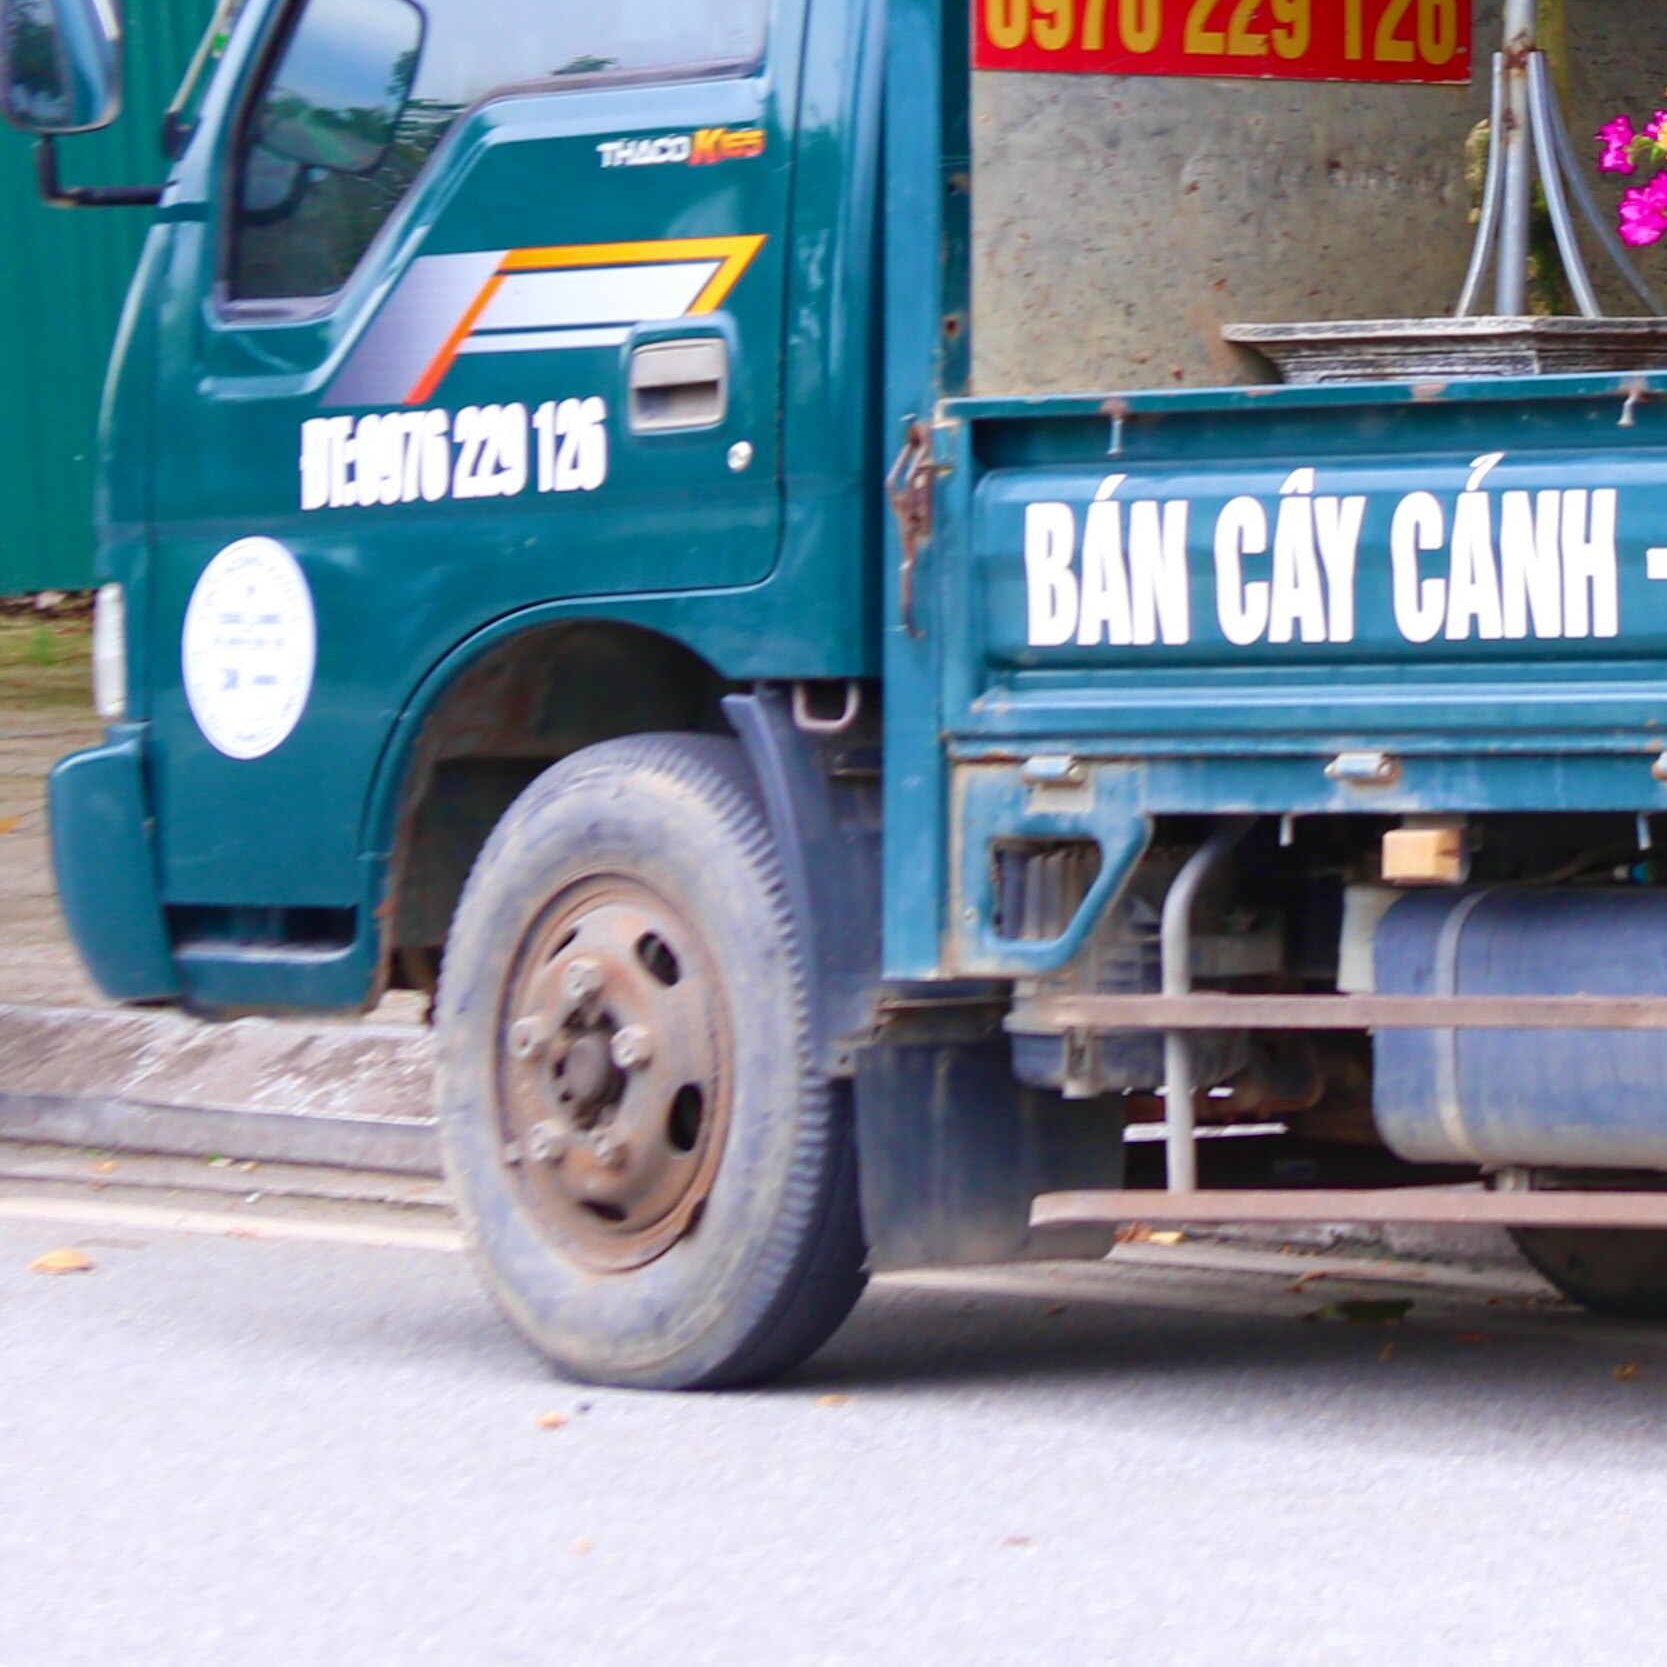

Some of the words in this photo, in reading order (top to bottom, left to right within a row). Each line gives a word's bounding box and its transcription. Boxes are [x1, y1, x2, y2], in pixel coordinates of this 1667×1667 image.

[596, 134, 692, 168] THACO
[451, 402, 528, 499] 229
[532, 395, 607, 493] 126
[1023, 473, 1191, 647] BÁN
[1213, 467, 1367, 646] CÂY
